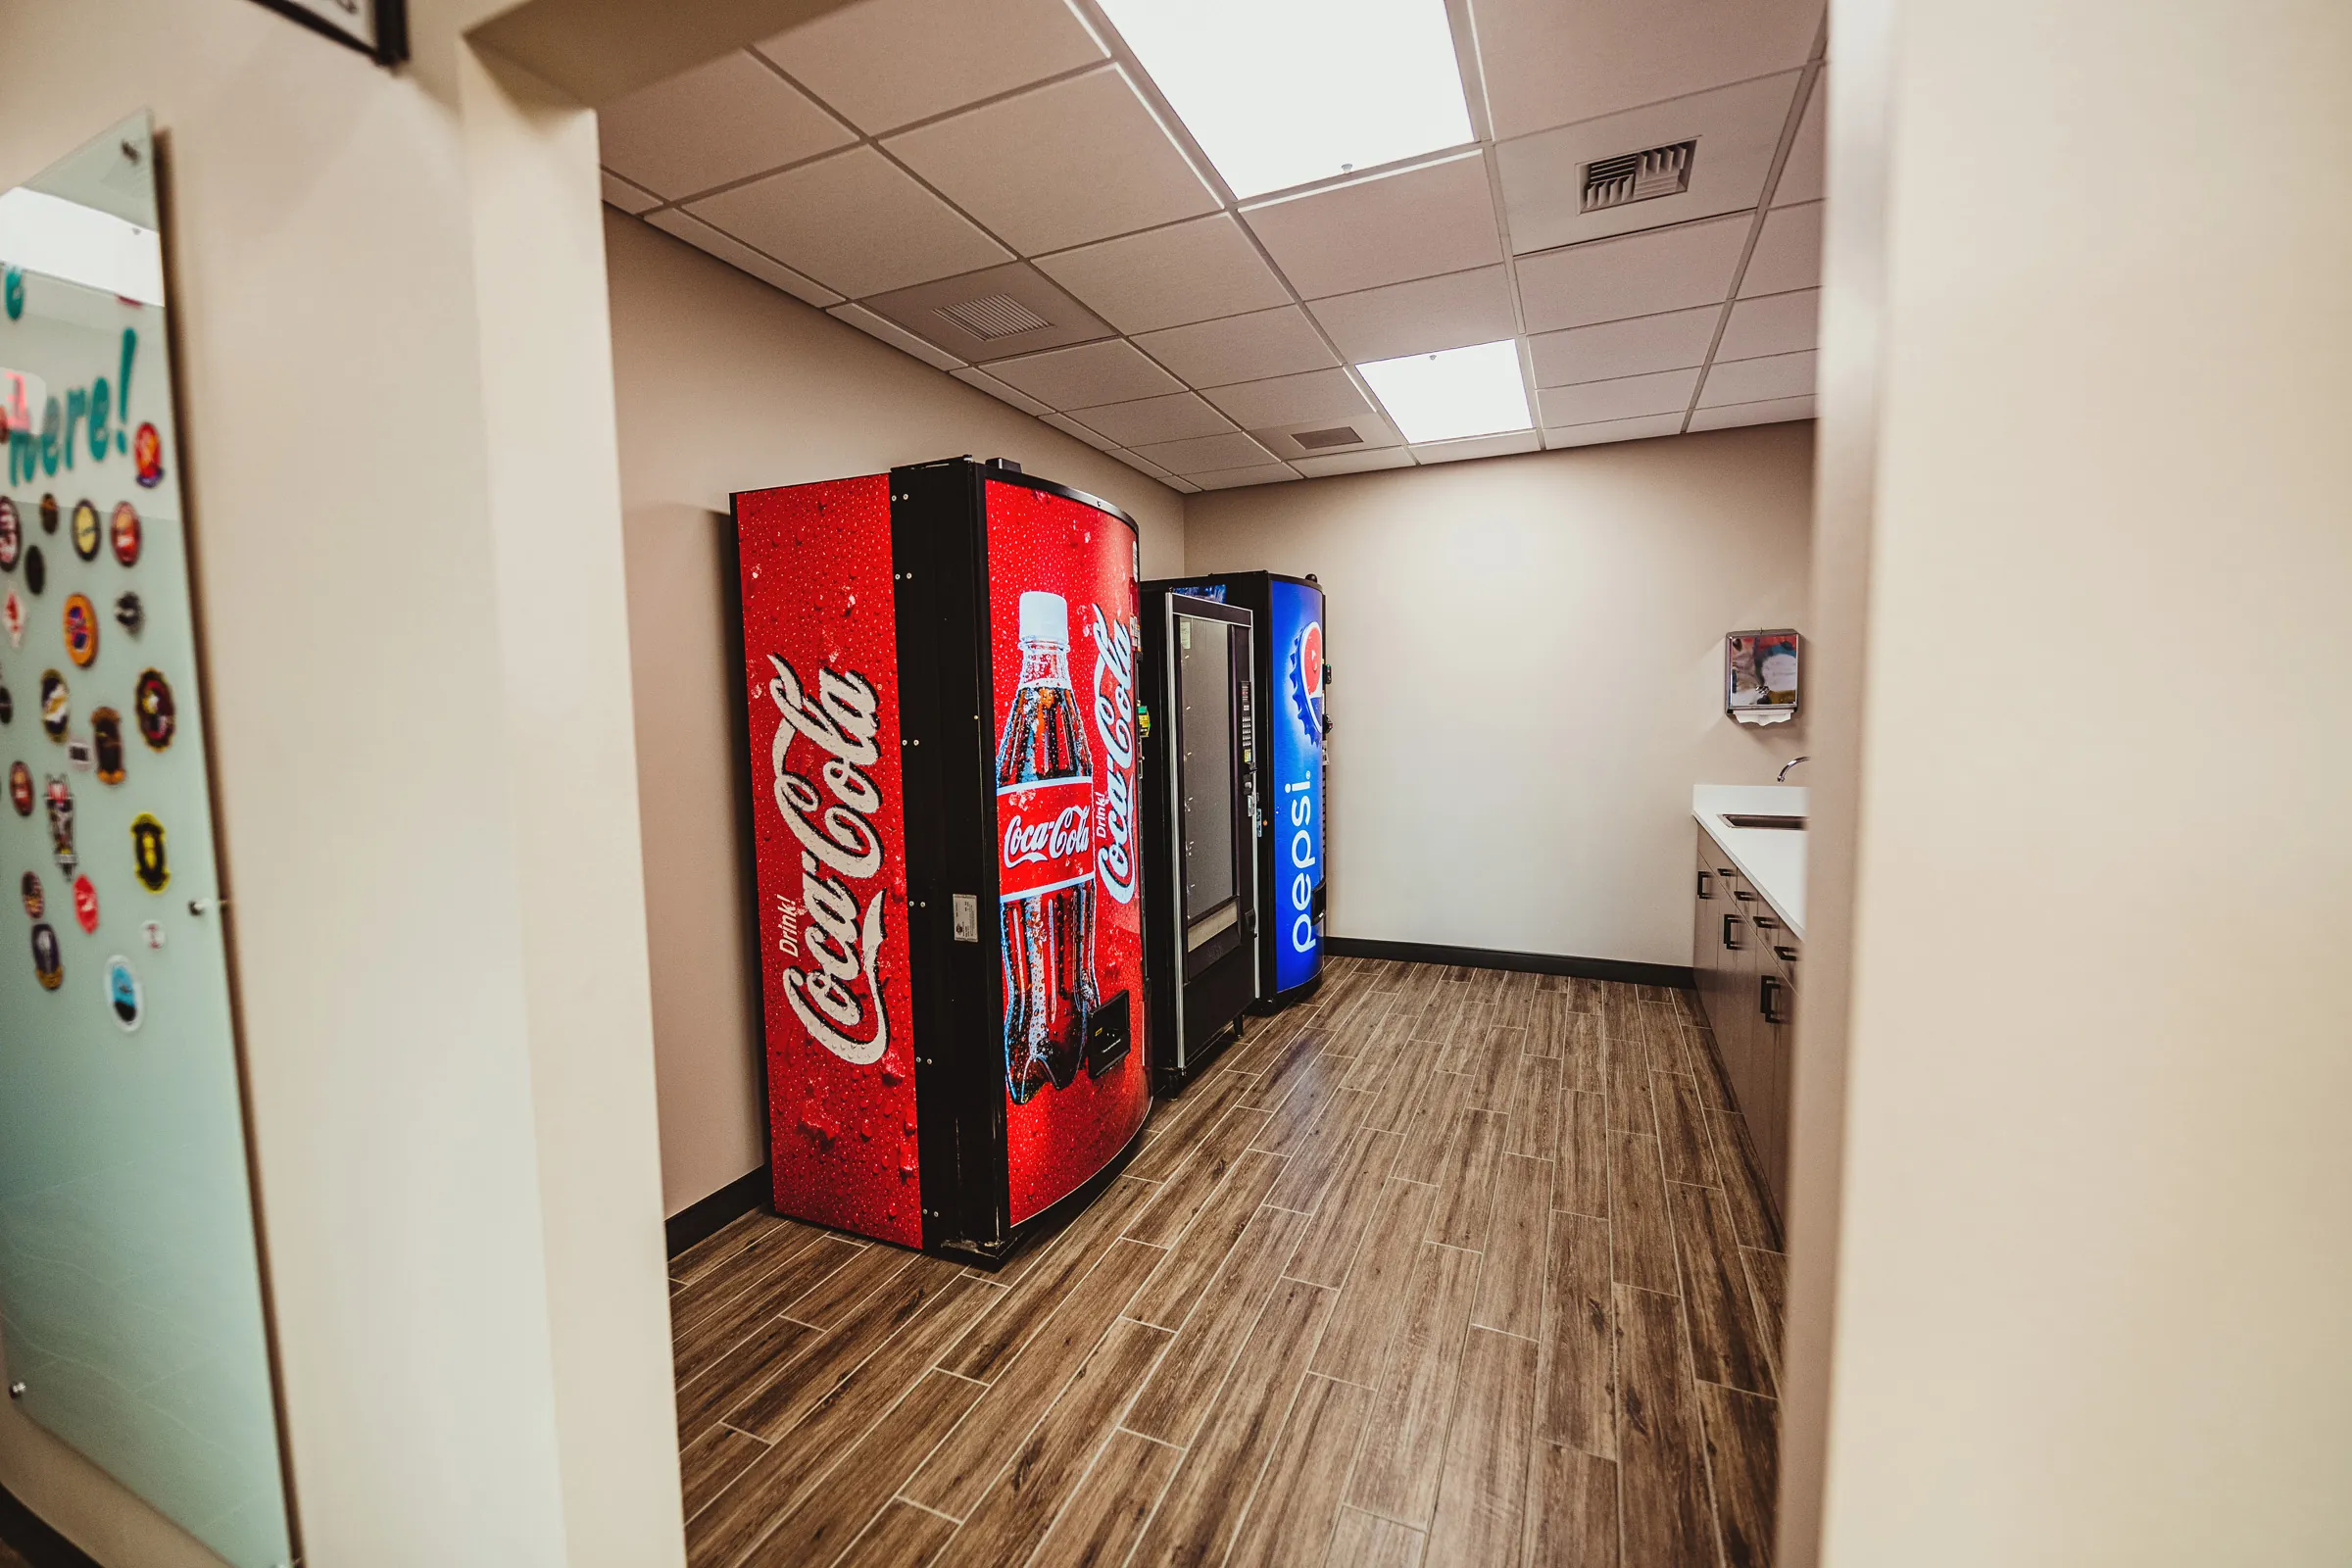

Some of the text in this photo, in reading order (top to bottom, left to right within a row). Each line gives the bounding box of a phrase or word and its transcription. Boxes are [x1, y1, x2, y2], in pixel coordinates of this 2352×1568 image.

[1092, 602, 1136, 905] Coca-Cola
[1003, 805, 1091, 869] Coca-Cola
[1095, 791, 1106, 839] Drink!
[767, 652, 890, 1066] Coca-Cola
[779, 895, 800, 958] Drink!
